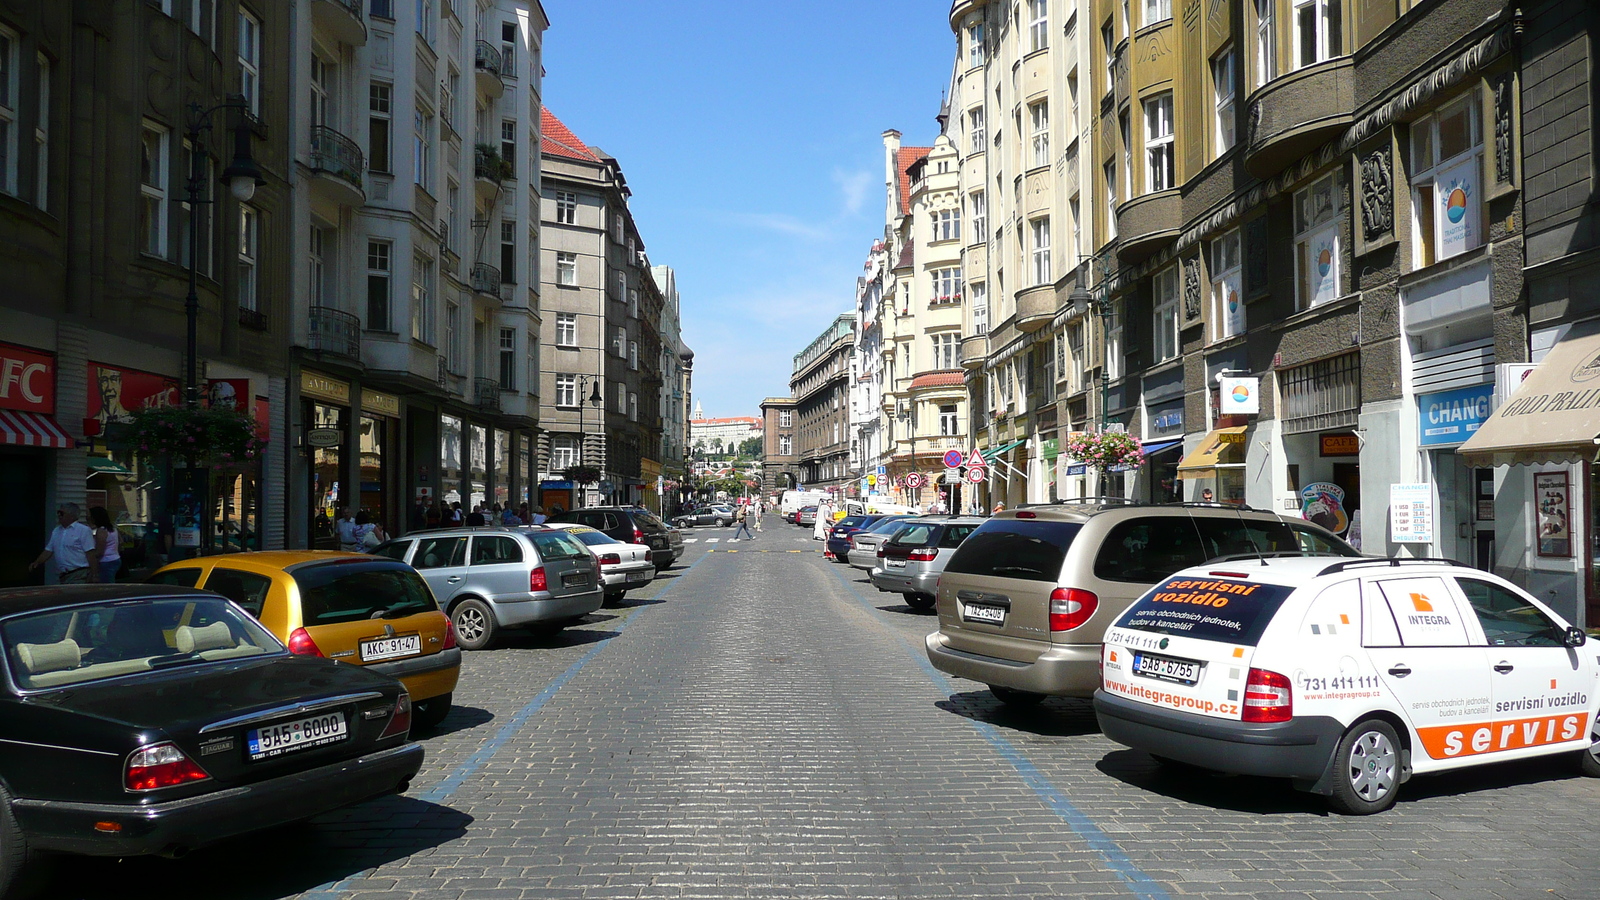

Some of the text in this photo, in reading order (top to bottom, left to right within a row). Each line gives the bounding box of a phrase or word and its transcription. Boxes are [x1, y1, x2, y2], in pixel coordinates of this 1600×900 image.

[1445, 222, 1470, 236] TRADITIONAL
[1454, 230, 1472, 242] MASSAGE
[0, 356, 46, 404] FC
[309, 379, 343, 394] ANTIQUE
[1501, 394, 1549, 418] GOLD
[1324, 438, 1356, 446] CAFE
[1166, 580, 1261, 596] servisní
[1152, 591, 1229, 608] vozidlo
[1156, 620, 1195, 631] kanceláří
[1157, 610, 1200, 622] obchodních
[1201, 615, 1242, 631] jednotek,
[1408, 615, 1451, 625] INTEGRA
[367, 642, 384, 655] AKC
[391, 638, 415, 651] 91-47
[1110, 632, 1158, 650] 731 411 111
[1106, 662, 1121, 670] INTEGRA
[1142, 656, 1193, 677] 5A8 6755
[1304, 676, 1378, 690] 731 411 111
[1106, 679, 1238, 714] www.integragroup.cz
[1304, 691, 1380, 700] www.integragroup.cz
[1496, 692, 1587, 712] servisní vozidlo
[1431, 699, 1464, 708] obchodních
[1439, 709, 1457, 717] budov
[262, 715, 338, 748] 5A5 6000
[1444, 716, 1578, 756] servis
[205, 743, 230, 754] JAGUAR
